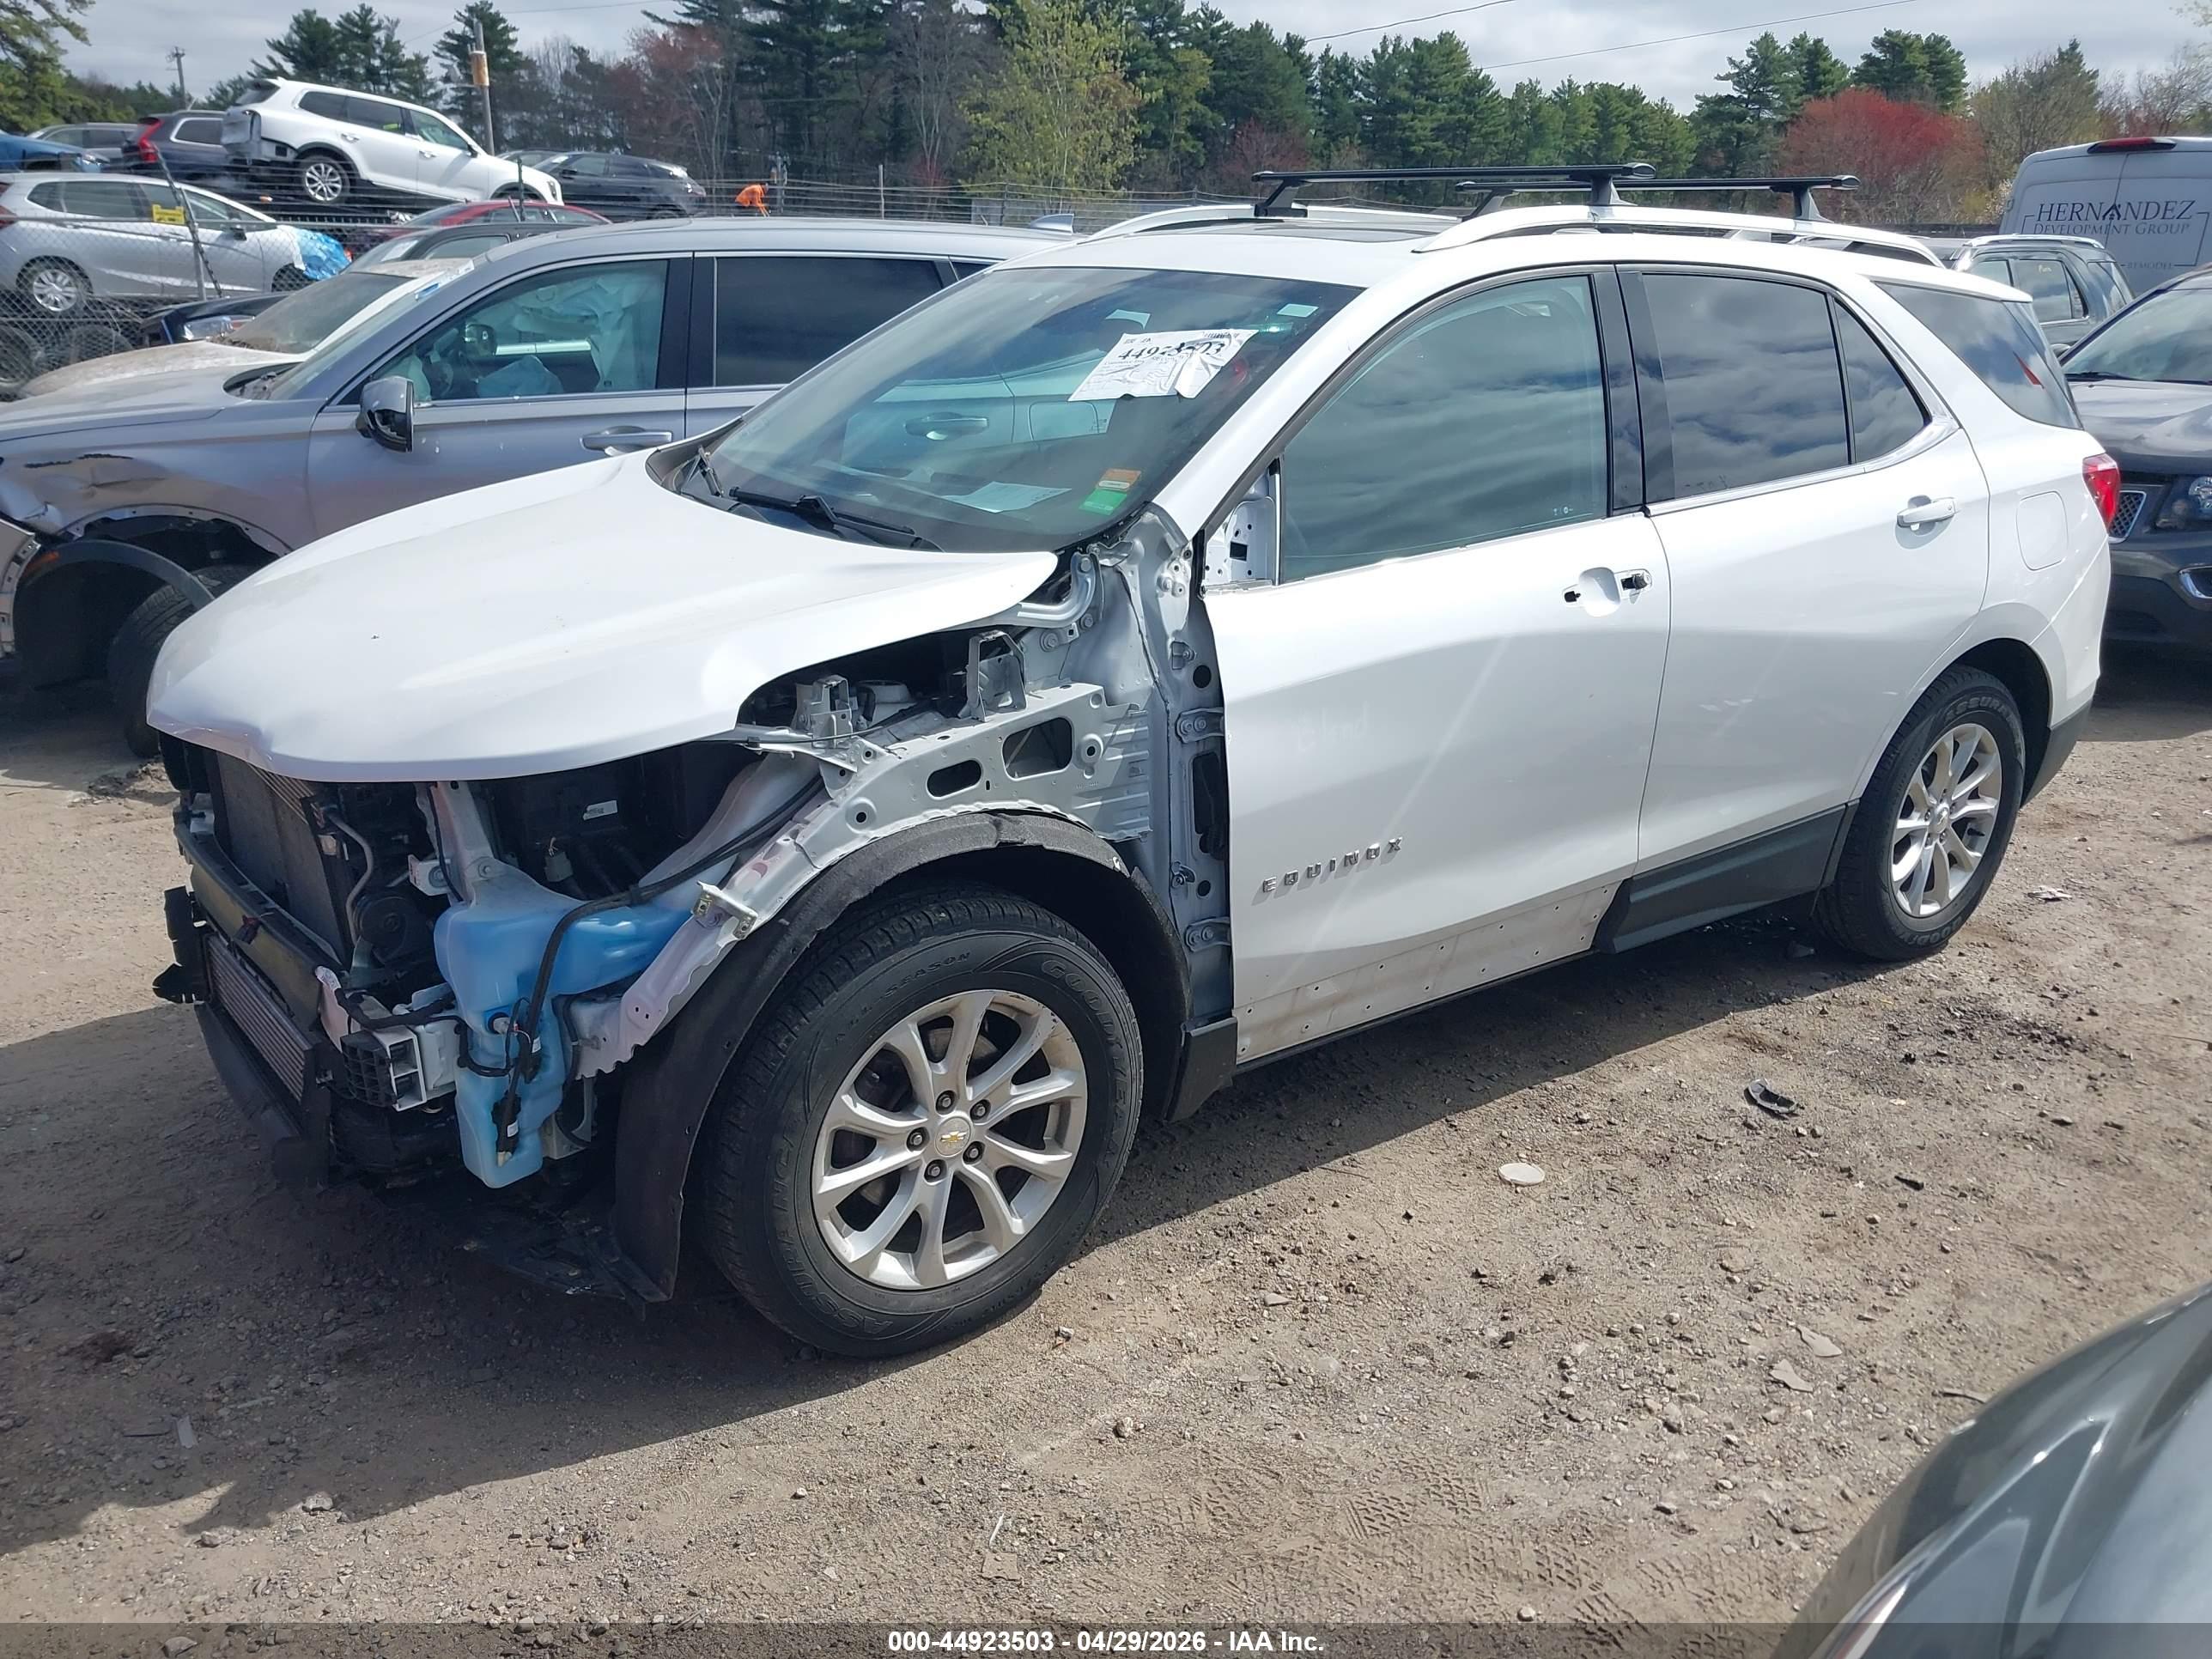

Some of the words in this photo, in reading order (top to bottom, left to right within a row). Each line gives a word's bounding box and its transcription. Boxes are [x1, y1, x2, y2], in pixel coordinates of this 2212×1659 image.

[2037, 200, 2196, 222] HERNANDEZ
[2033, 222, 2131, 235] DEVELOPMENT
[2136, 222, 2191, 235] GROUP
[1262, 836, 1402, 893] EQUINOX
